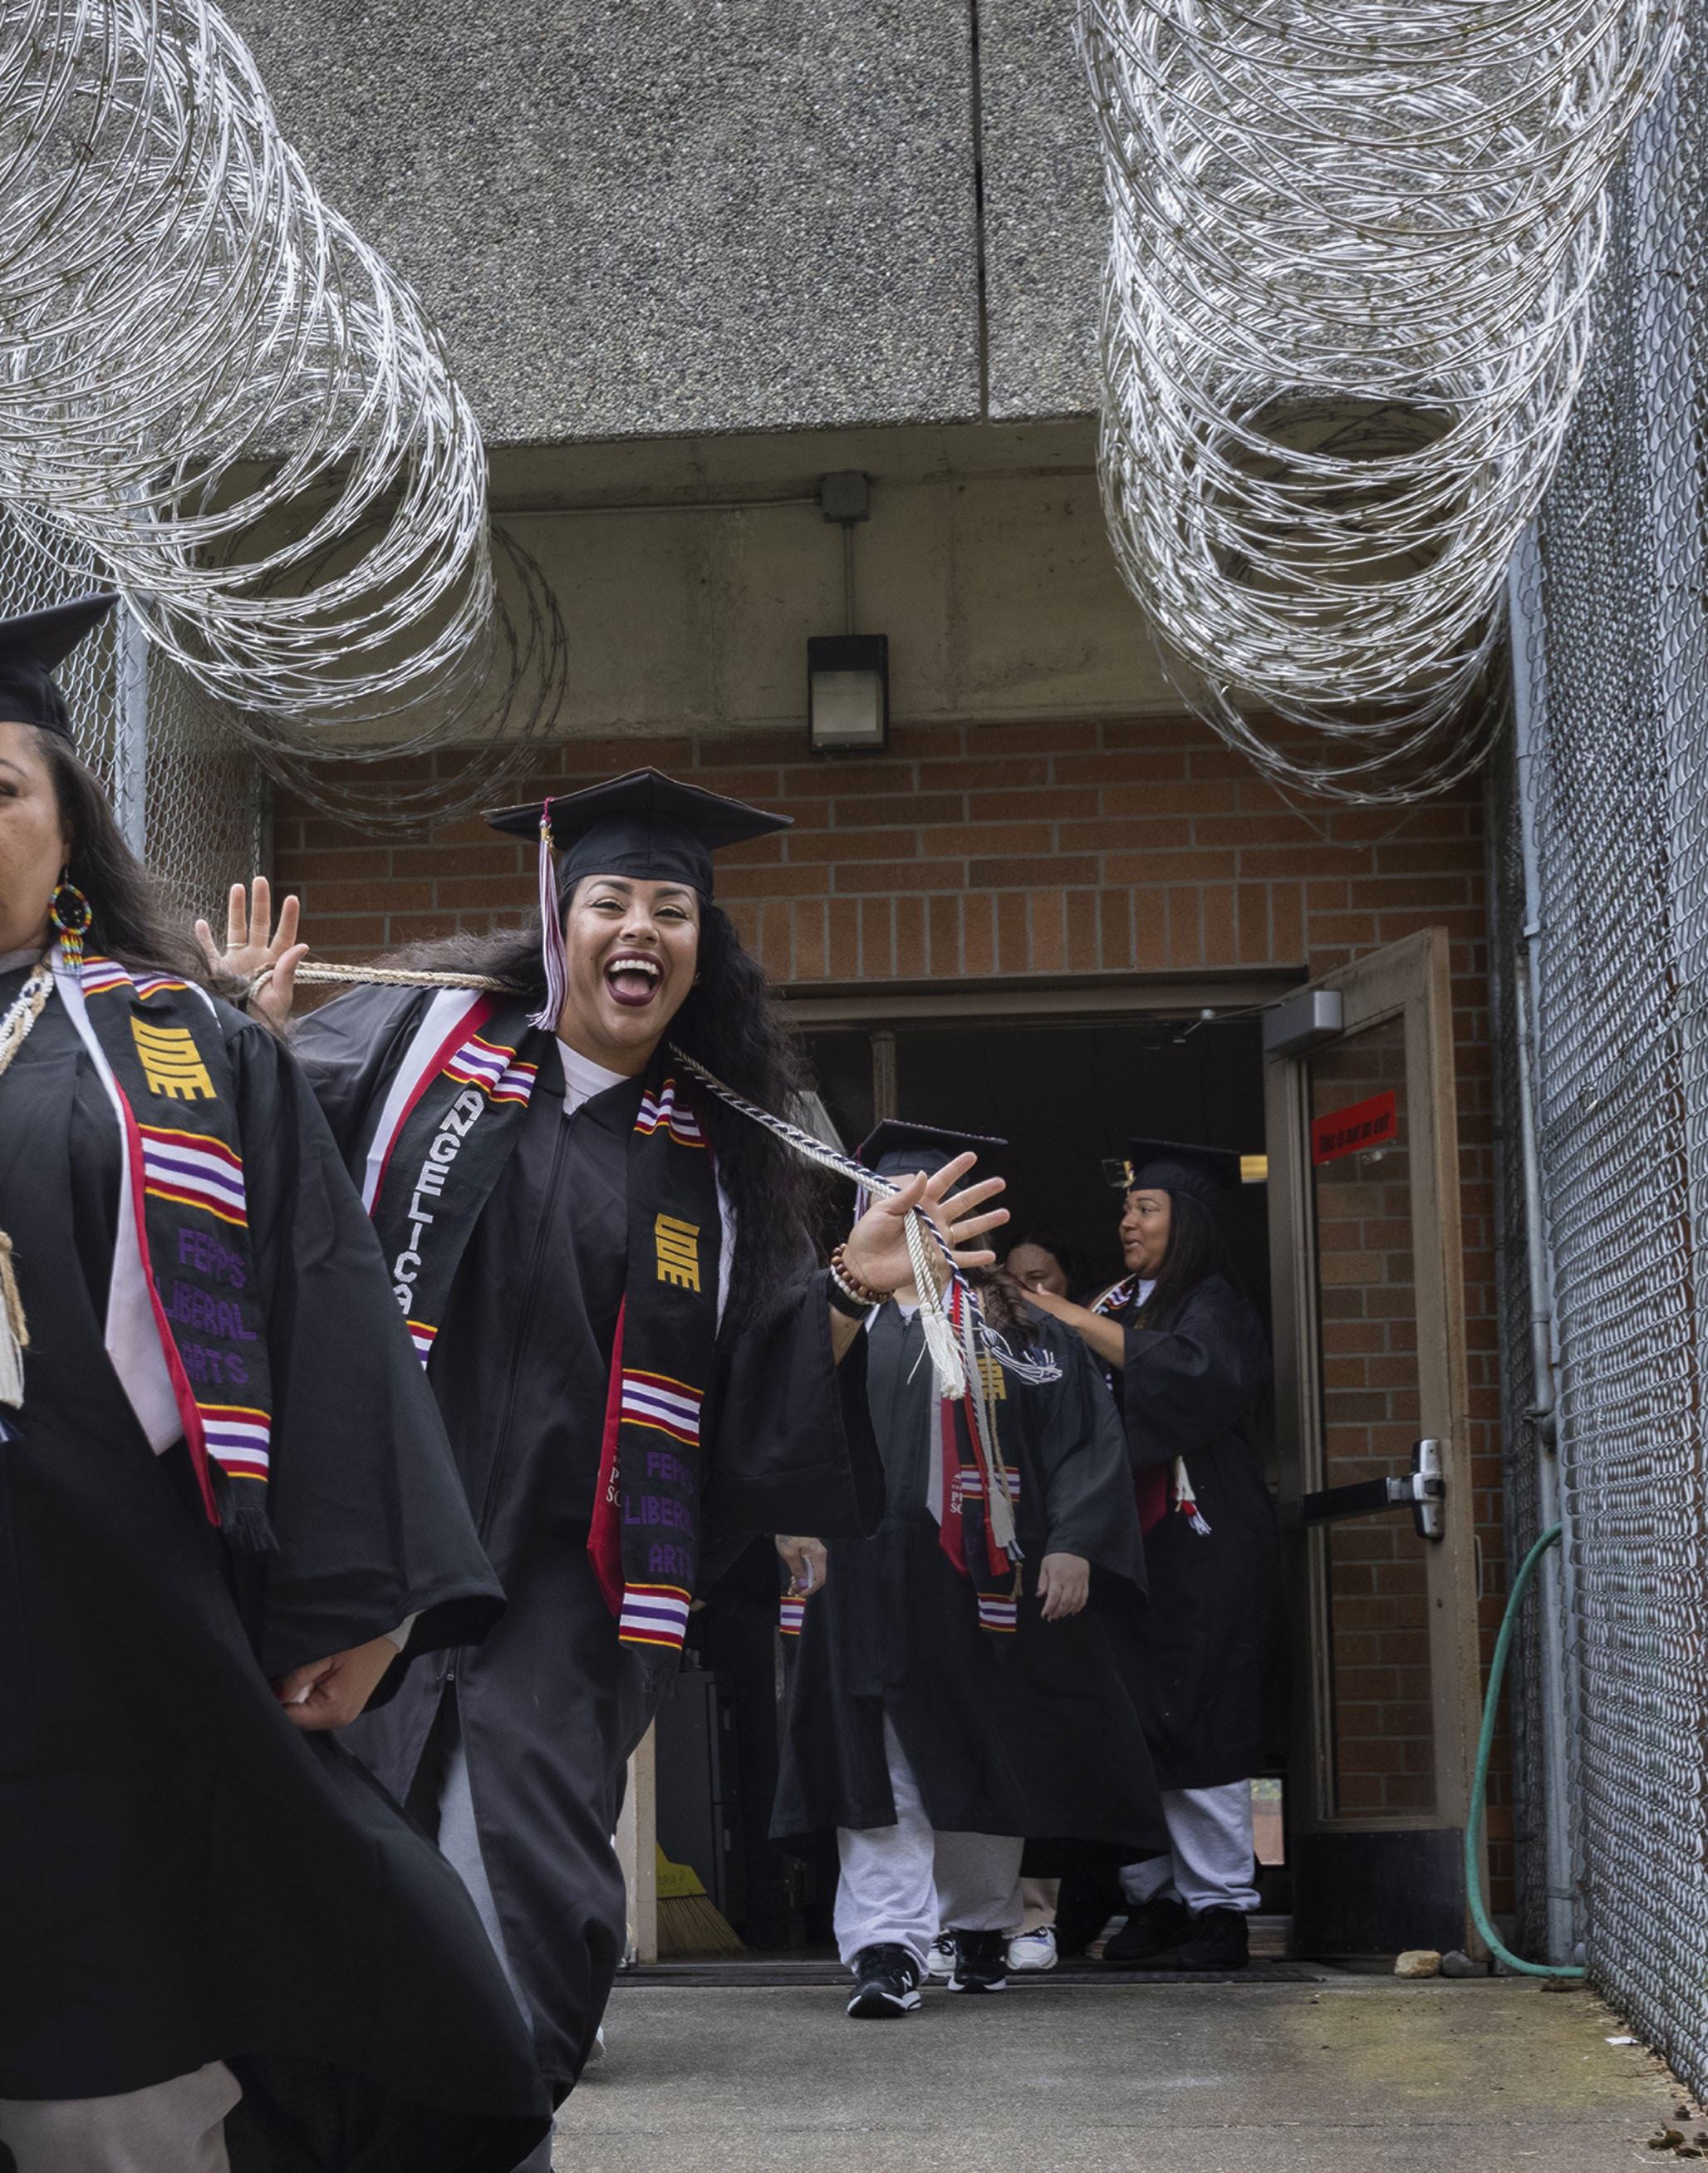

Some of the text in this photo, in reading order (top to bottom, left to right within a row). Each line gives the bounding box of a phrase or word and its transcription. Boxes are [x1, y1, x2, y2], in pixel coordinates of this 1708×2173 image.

[393, 1089, 484, 1315] ANGELICA
[179, 1227, 248, 1290] FEPPS
[155, 1276, 258, 1341] LIBERAL
[181, 1339, 248, 1384] ARTS
